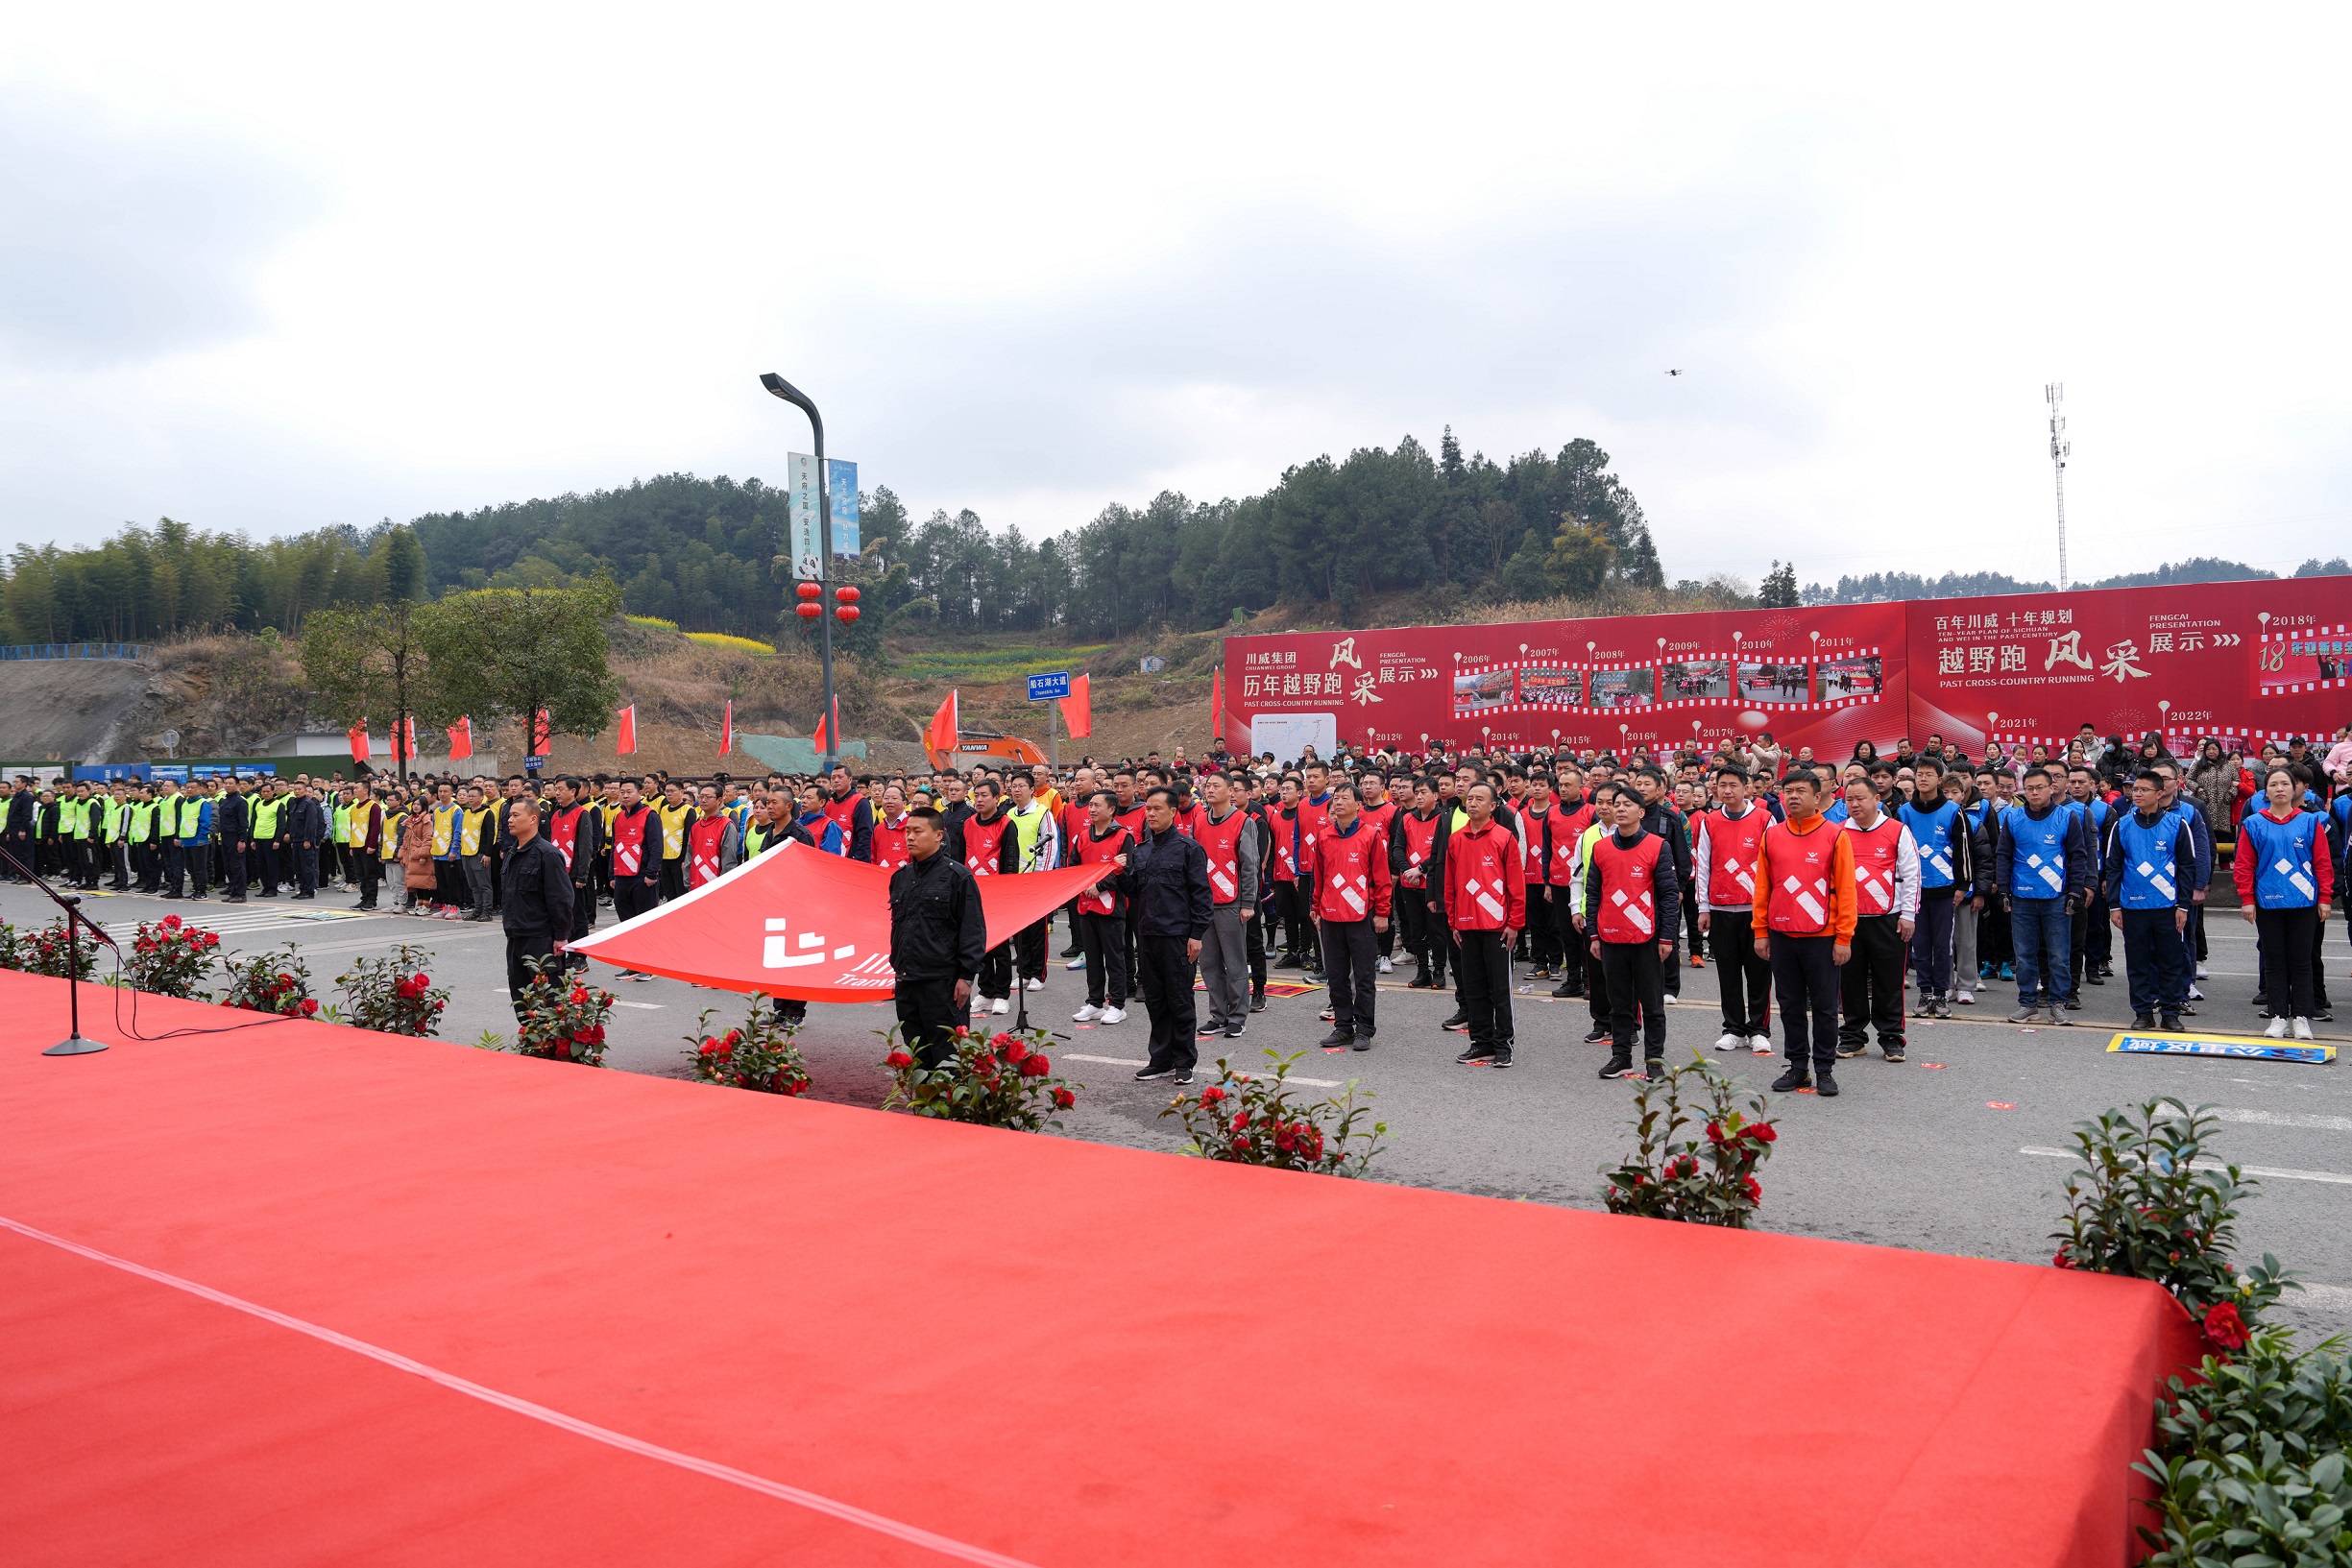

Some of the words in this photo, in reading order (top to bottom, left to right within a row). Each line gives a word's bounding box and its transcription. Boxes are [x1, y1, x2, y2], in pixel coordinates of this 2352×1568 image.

[1934, 613, 2000, 631] 百年川威
[2006, 609, 2073, 627] 十年规划
[2149, 620, 2220, 629] PRESENTATION
[2272, 615, 2316, 626] 2018年
[1668, 641, 1700, 651] 2009年
[1741, 639, 1775, 649] 2010年
[1820, 638, 1855, 647] 2011年
[1246, 651, 1297, 664] 川威集团
[1530, 648, 1559, 658] 2007年
[1594, 650, 1625, 660] 2008年
[1938, 644, 2027, 675] 越野跑
[2148, 631, 2204, 653] 展示
[1463, 654, 1491, 663] 2006年
[1244, 672, 1343, 697] 历年越野跑
[1378, 666, 1416, 684] 展示
[1940, 680, 1964, 688] PAST
[1965, 677, 2047, 688] CROSS-COUNTRY
[2048, 674, 2095, 684] RUNNING
[2170, 710, 2213, 721] 2022年
[2000, 718, 2038, 728] 2021年
[1375, 733, 1403, 741] 2012年
[1491, 732, 1520, 741] 2014年
[1627, 732, 1658, 740] 2016年
[1703, 728, 1734, 737] 2017年
[1561, 736, 1591, 744] 2015年
